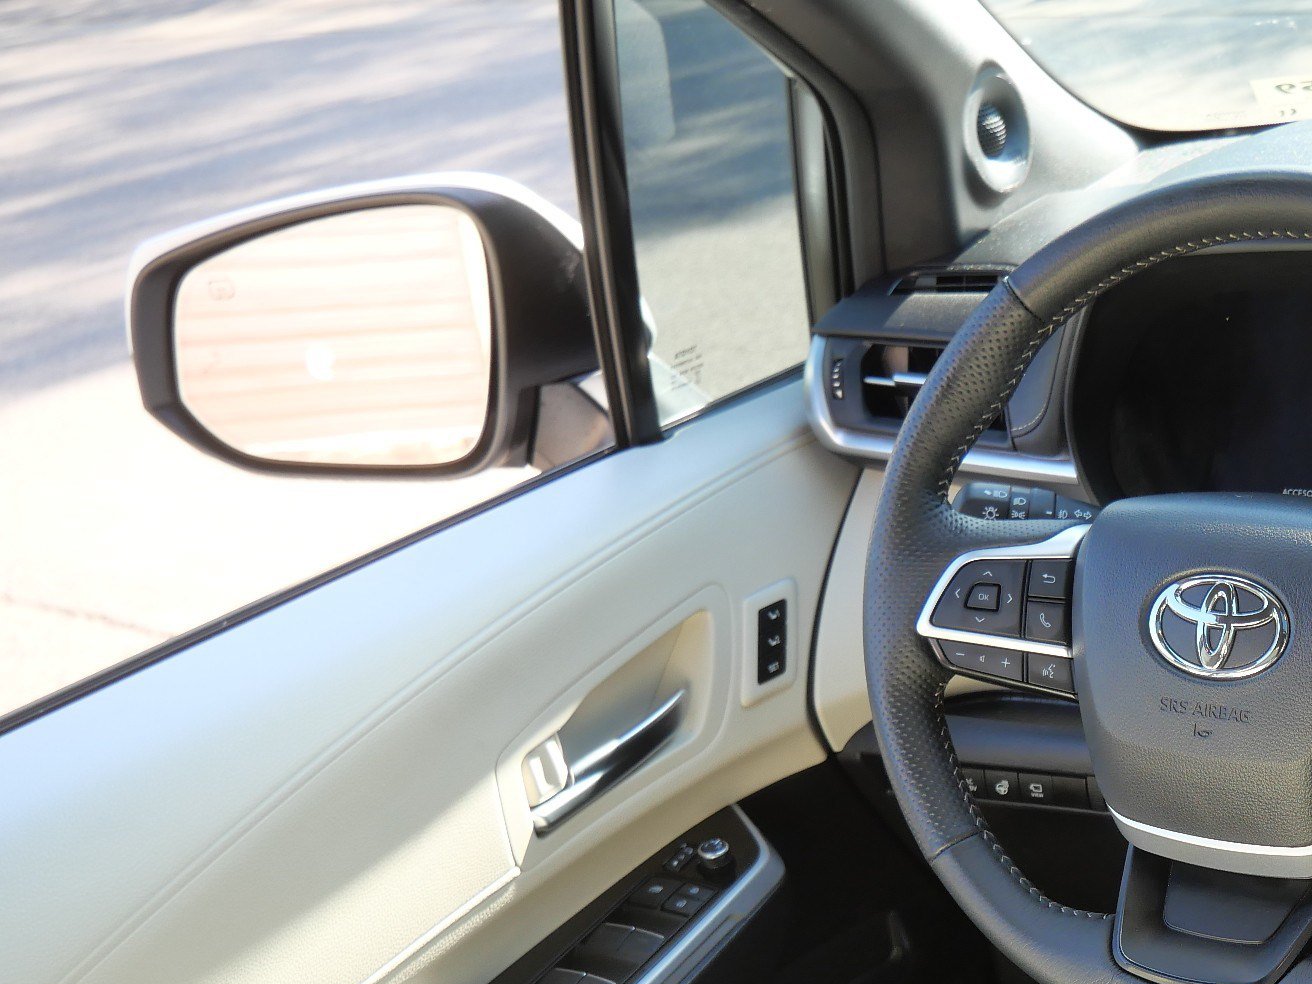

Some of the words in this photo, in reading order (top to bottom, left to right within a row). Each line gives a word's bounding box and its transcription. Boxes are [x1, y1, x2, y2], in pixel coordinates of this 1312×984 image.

[978, 593, 990, 601] OK
[1160, 697, 1189, 714] SRS
[1192, 702, 1251, 723] AIRBAG
